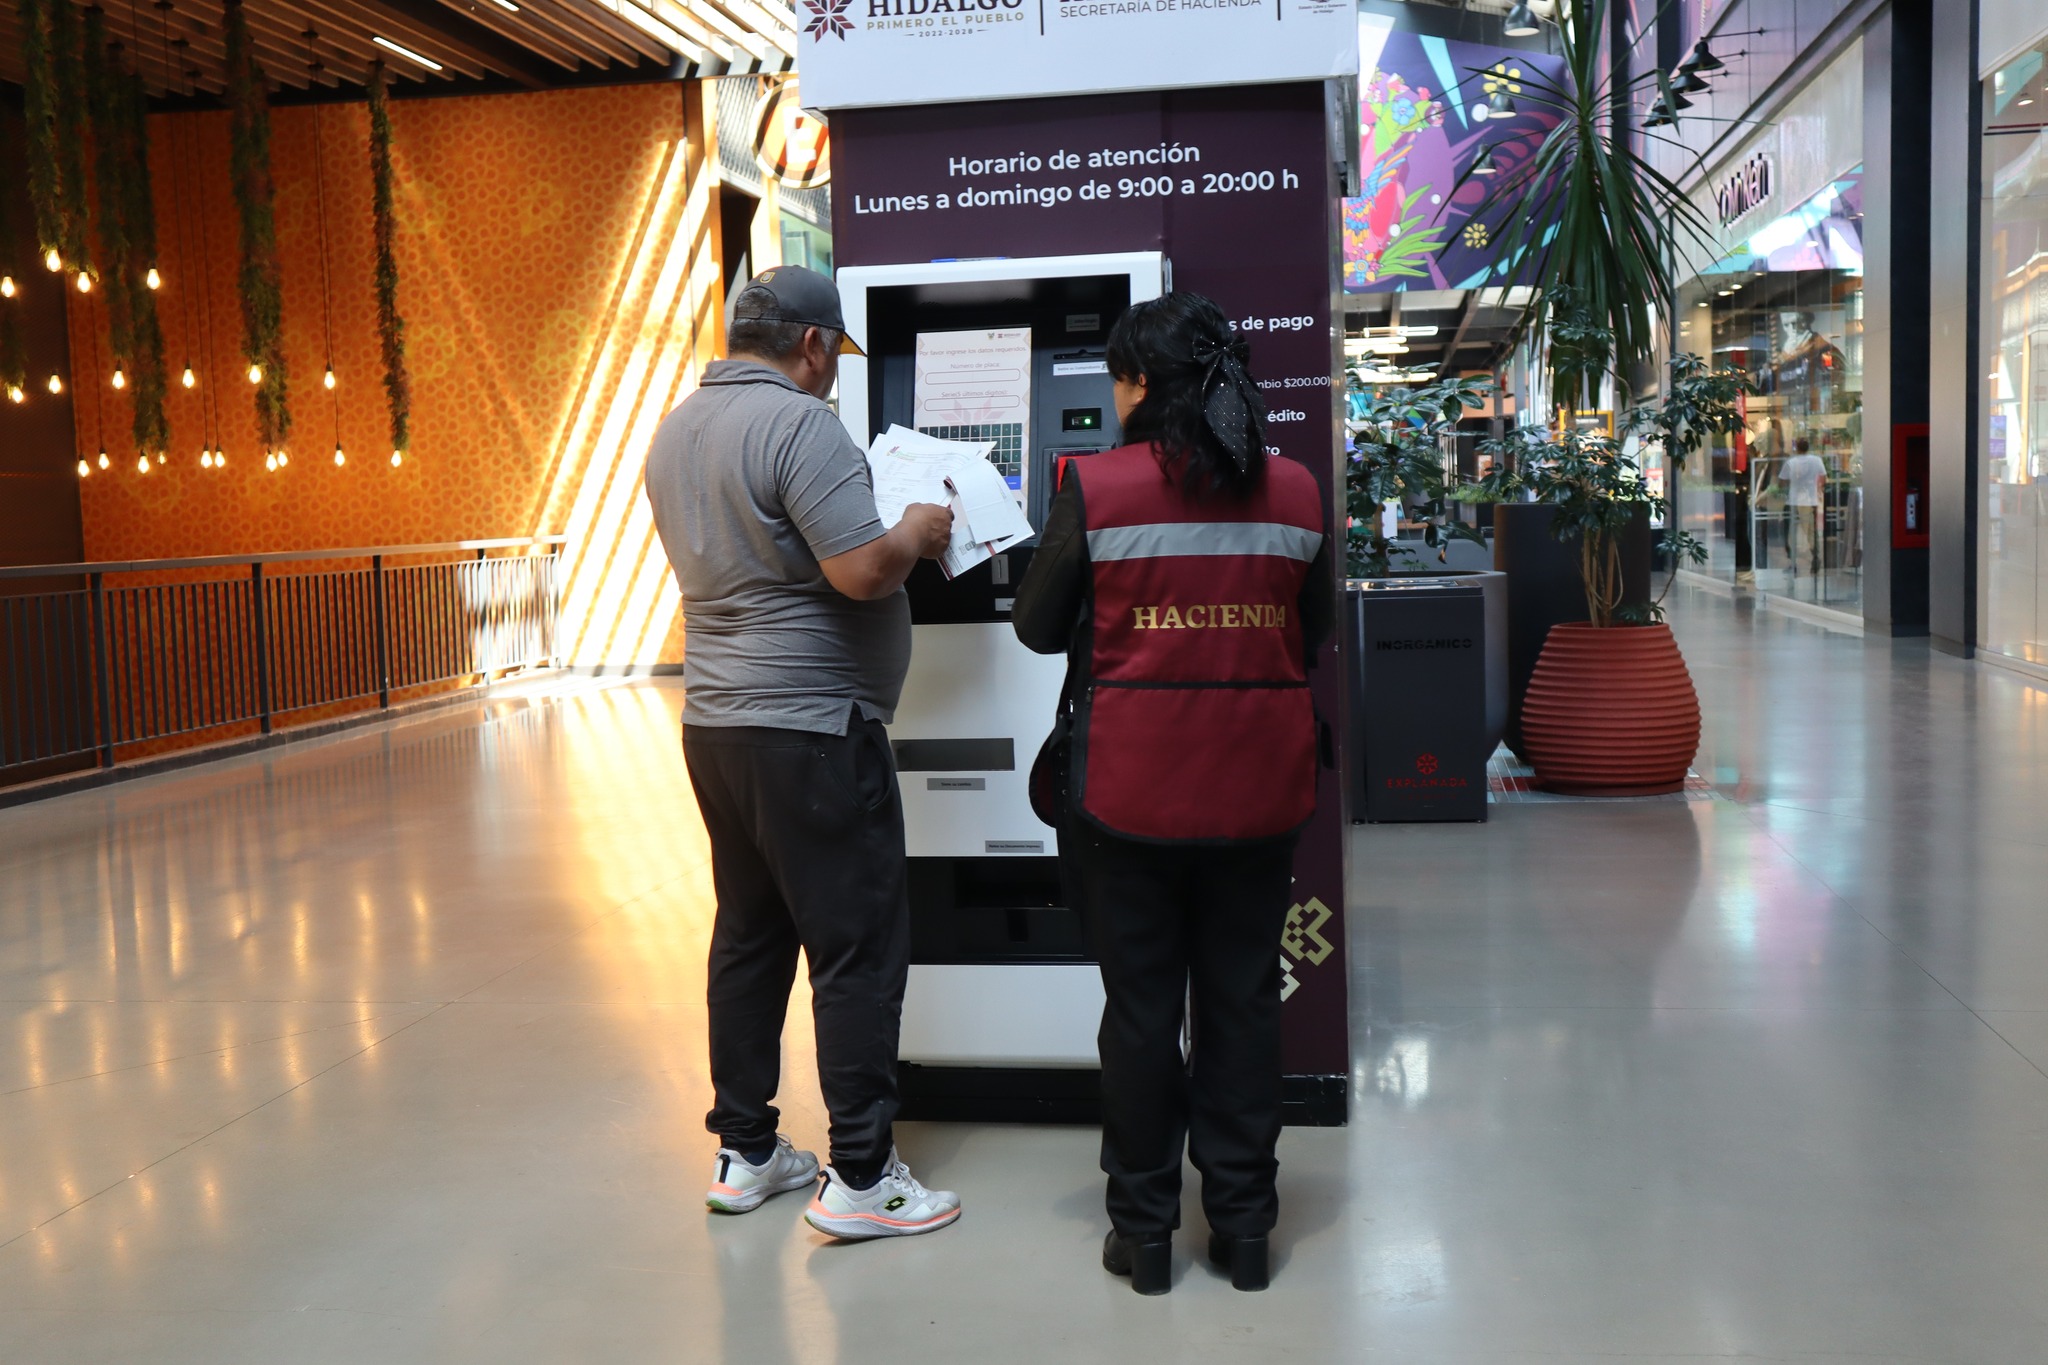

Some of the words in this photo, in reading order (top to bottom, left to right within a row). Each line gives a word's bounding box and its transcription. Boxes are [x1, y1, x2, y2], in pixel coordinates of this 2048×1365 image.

[1156, 0, 1176, 11] DE
[867, 17, 934, 30] PRIMERO
[942, 16, 958, 26] EL
[965, 12, 1024, 24] PUEBLO
[919, 28, 973, 37] 2022-2028
[948, 150, 1042, 176] Horario
[1048, 149, 1081, 170] de
[1088, 142, 1200, 168] atención
[854, 192, 930, 214] Lunes
[936, 193, 950, 208] a
[957, 183, 1073, 207] domingo
[1079, 179, 1111, 200] de
[1117, 176, 1174, 198] 9:00
[1181, 178, 1196, 195] a
[1202, 170, 1275, 193] 20:00
[1283, 168, 1300, 189] h
[1241, 316, 1264, 331] de
[1269, 315, 1314, 332] pago
[1256, 378, 1282, 389] mbio
[1284, 375, 1331, 389] $200.00)
[1267, 408, 1306, 422] édito
[1132, 604, 1286, 629] HACIENDA
